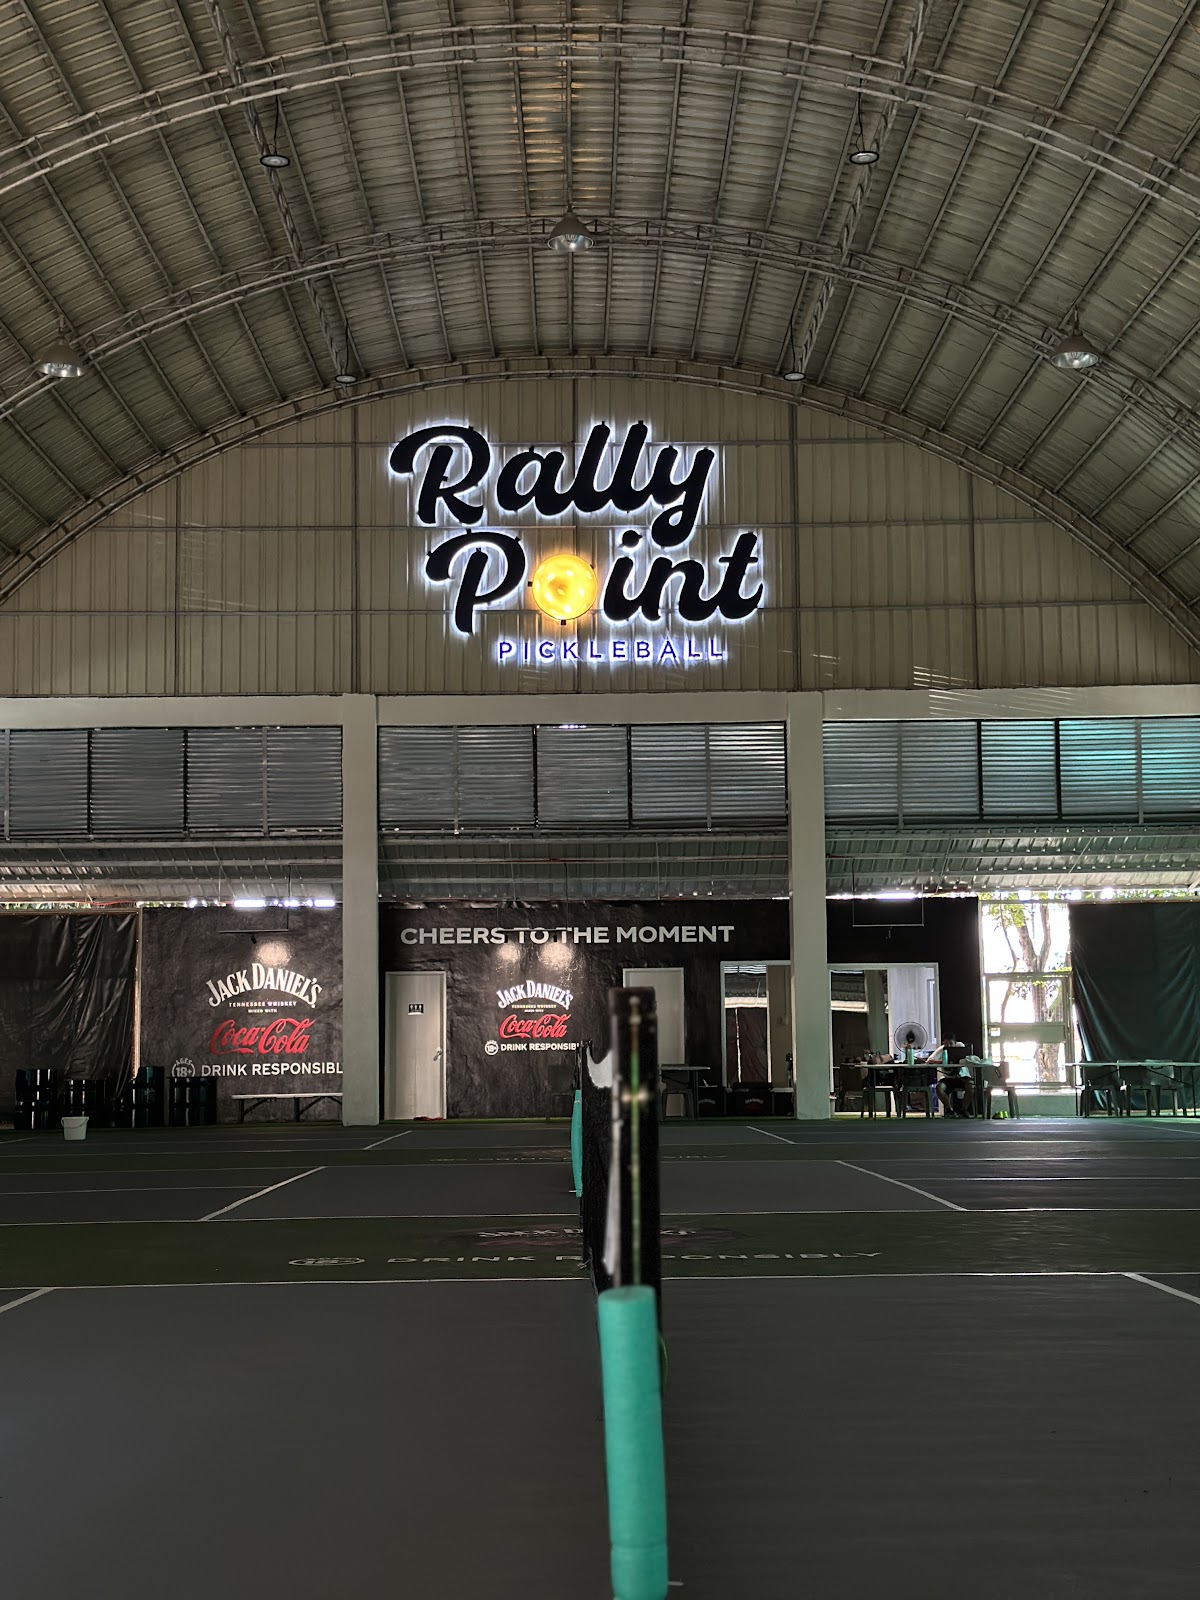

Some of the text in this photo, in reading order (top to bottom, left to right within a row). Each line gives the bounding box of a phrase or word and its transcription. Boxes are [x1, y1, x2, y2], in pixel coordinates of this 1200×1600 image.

[389, 420, 715, 547] Rally
[425, 529, 764, 634] Point
[499, 640, 724, 660] PICKLEBALL
[400, 925, 735, 945] CHEERS TO THE MOMENT
[205, 962, 323, 1009] JACK DANIEL'S
[496, 980, 573, 1010] JACK DANIEL'S
[210, 1018, 316, 1055] Coca-Cola
[499, 1014, 571, 1038] Coca-Cola
[500, 1042, 580, 1052] DRINK RESPONSIB
[201, 1061, 343, 1077] DRINK RESPONSIBL
[387, 1255, 536, 1263] DRINK
